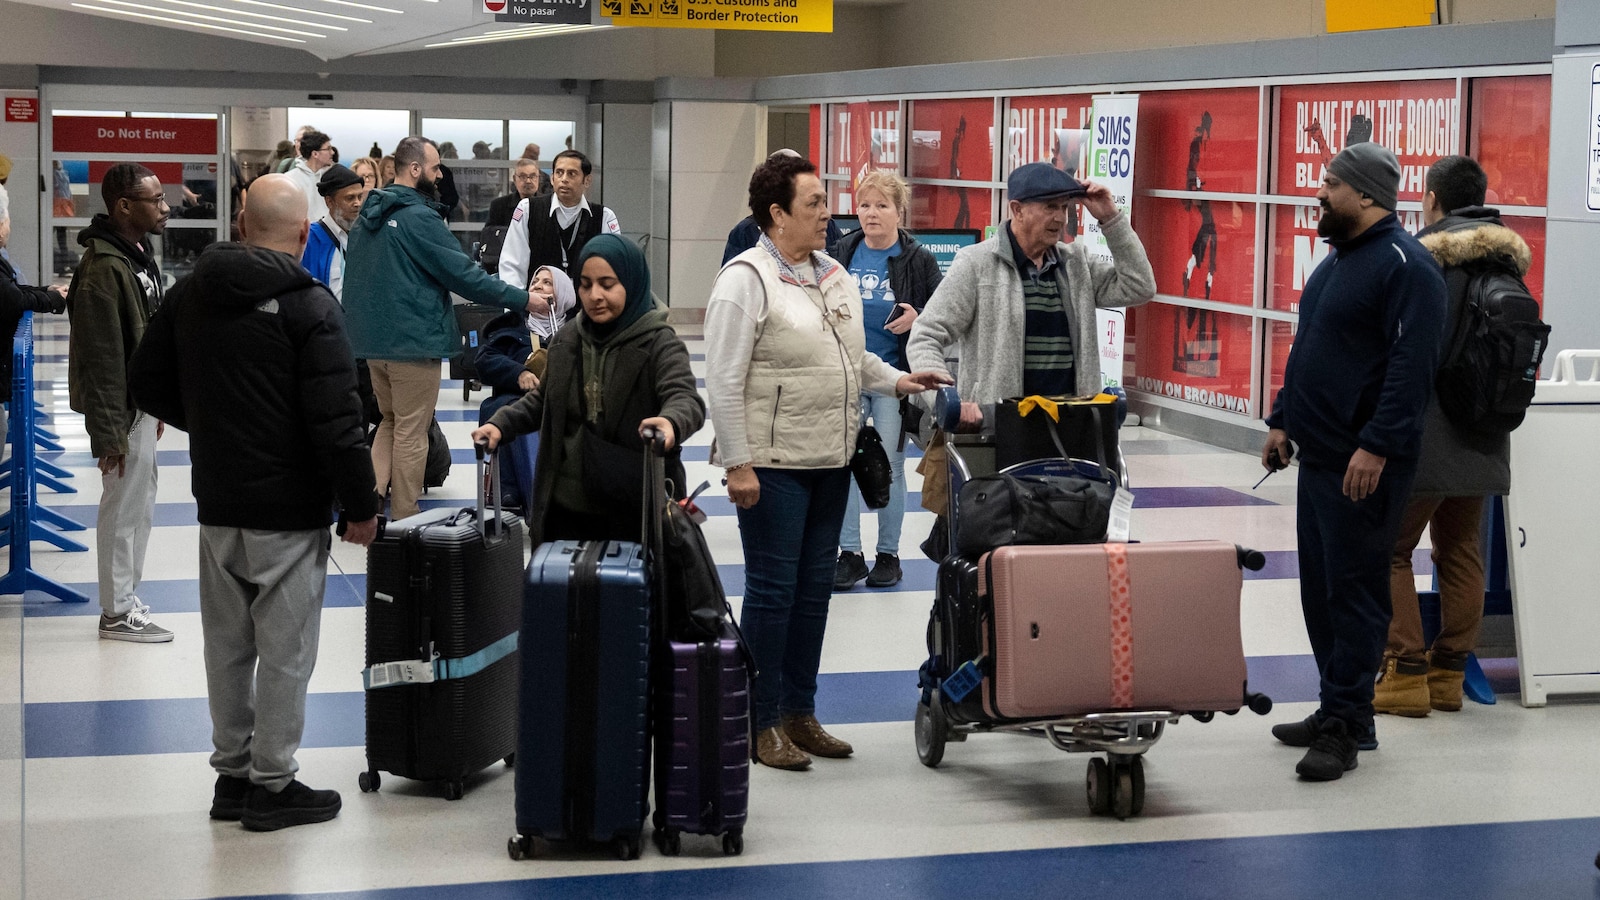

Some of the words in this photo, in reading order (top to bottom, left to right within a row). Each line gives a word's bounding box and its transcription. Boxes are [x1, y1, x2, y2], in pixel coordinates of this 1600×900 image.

[513, 5, 527, 15] No
[530, 7, 557, 18] pasar
[773, 0, 797, 8] and
[687, 9, 729, 21] Border
[734, 10, 798, 24] Protection
[97, 128, 115, 139] Do
[118, 128, 141, 139] Not
[144, 128, 177, 140] Enter
[1097, 116, 1131, 146] SIMS
[1296, 101, 1338, 154] BLAME
[1378, 99, 1403, 156] THE
[1109, 147, 1131, 178] GO
[1295, 162, 1328, 188] BLA
[1104, 375, 1117, 387] Lyca
[1136, 376, 1164, 394] NOW
[1165, 381, 1182, 398] ON
[1184, 385, 1252, 414] BROADWAY
